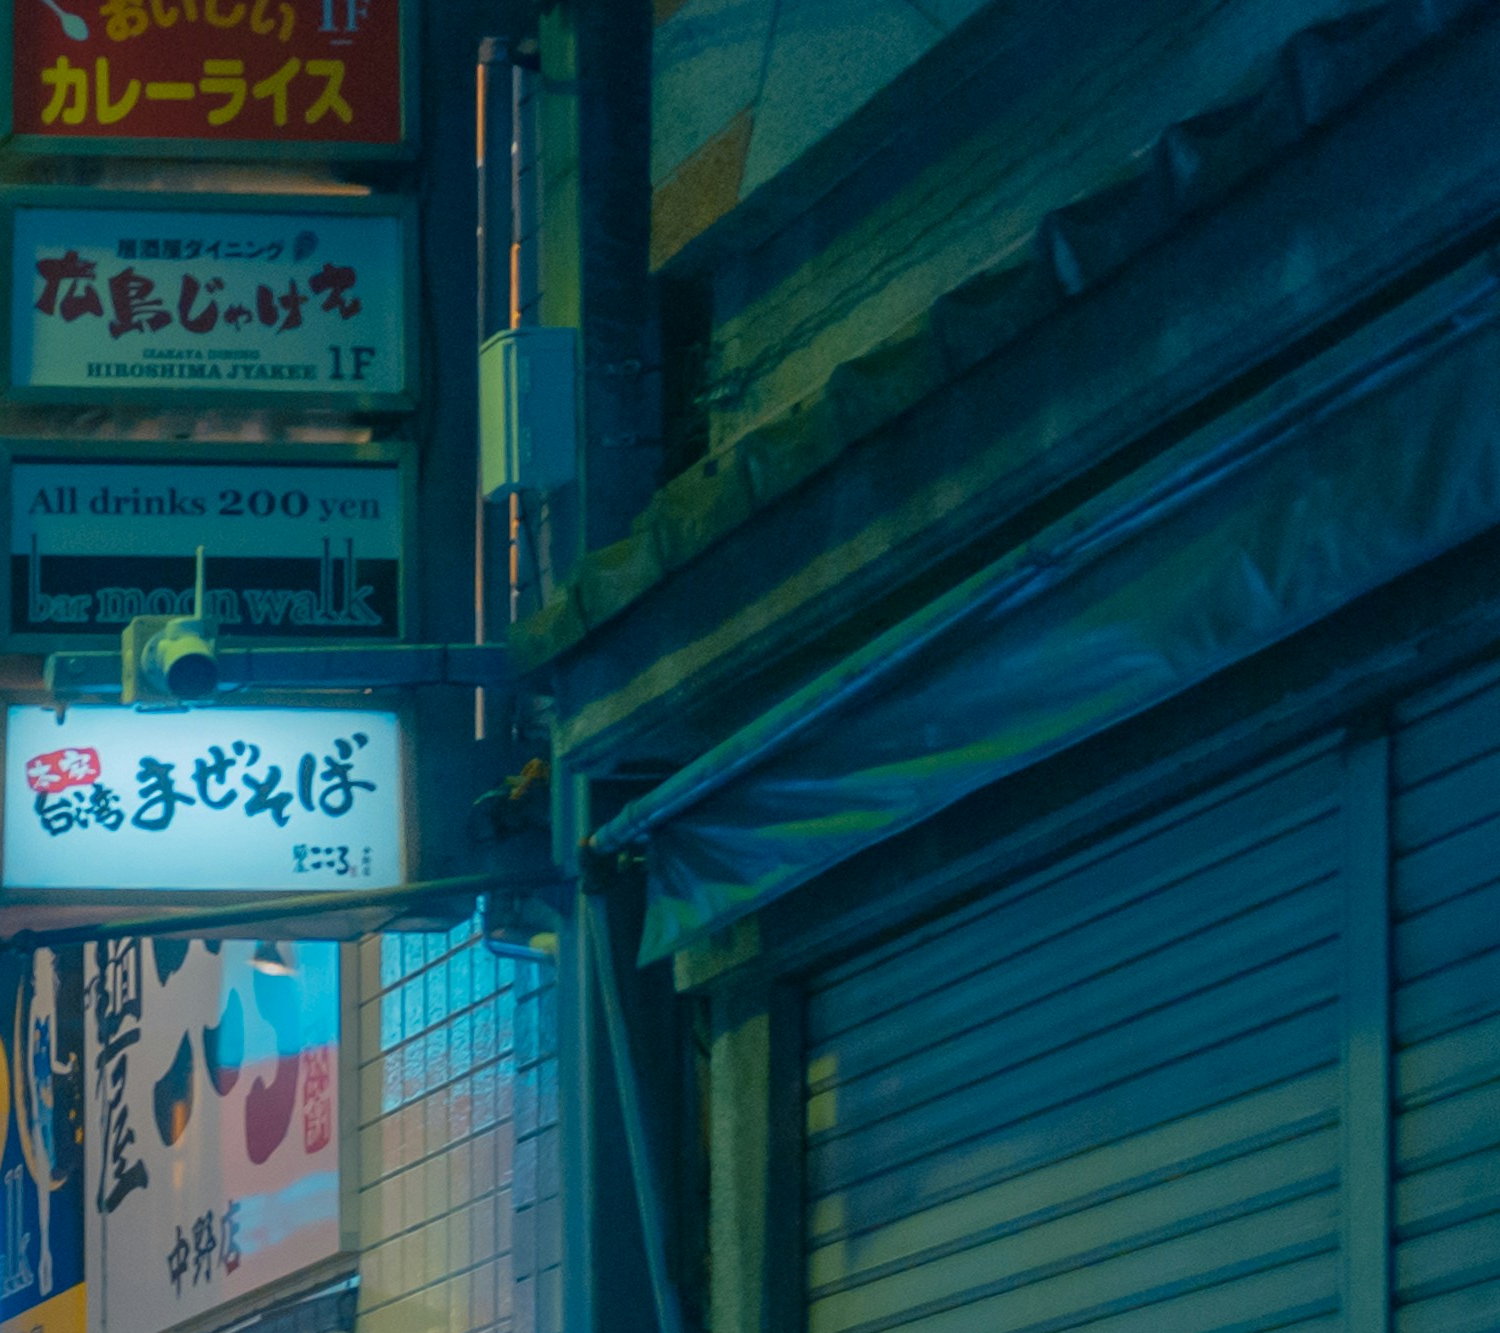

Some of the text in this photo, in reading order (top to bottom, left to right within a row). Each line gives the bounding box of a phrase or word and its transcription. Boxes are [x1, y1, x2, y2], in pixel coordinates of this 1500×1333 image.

[41, 55, 353, 125] カレーライス
[87, 362, 319, 381] HIROSHIMA JYAKEE
[329, 346, 376, 381] 1F
[28, 486, 382, 523] All drinks 200 yen
[243, 537, 383, 626] walk
[132, 731, 378, 832] まぜそば
[167, 1199, 241, 1298] 中野店
